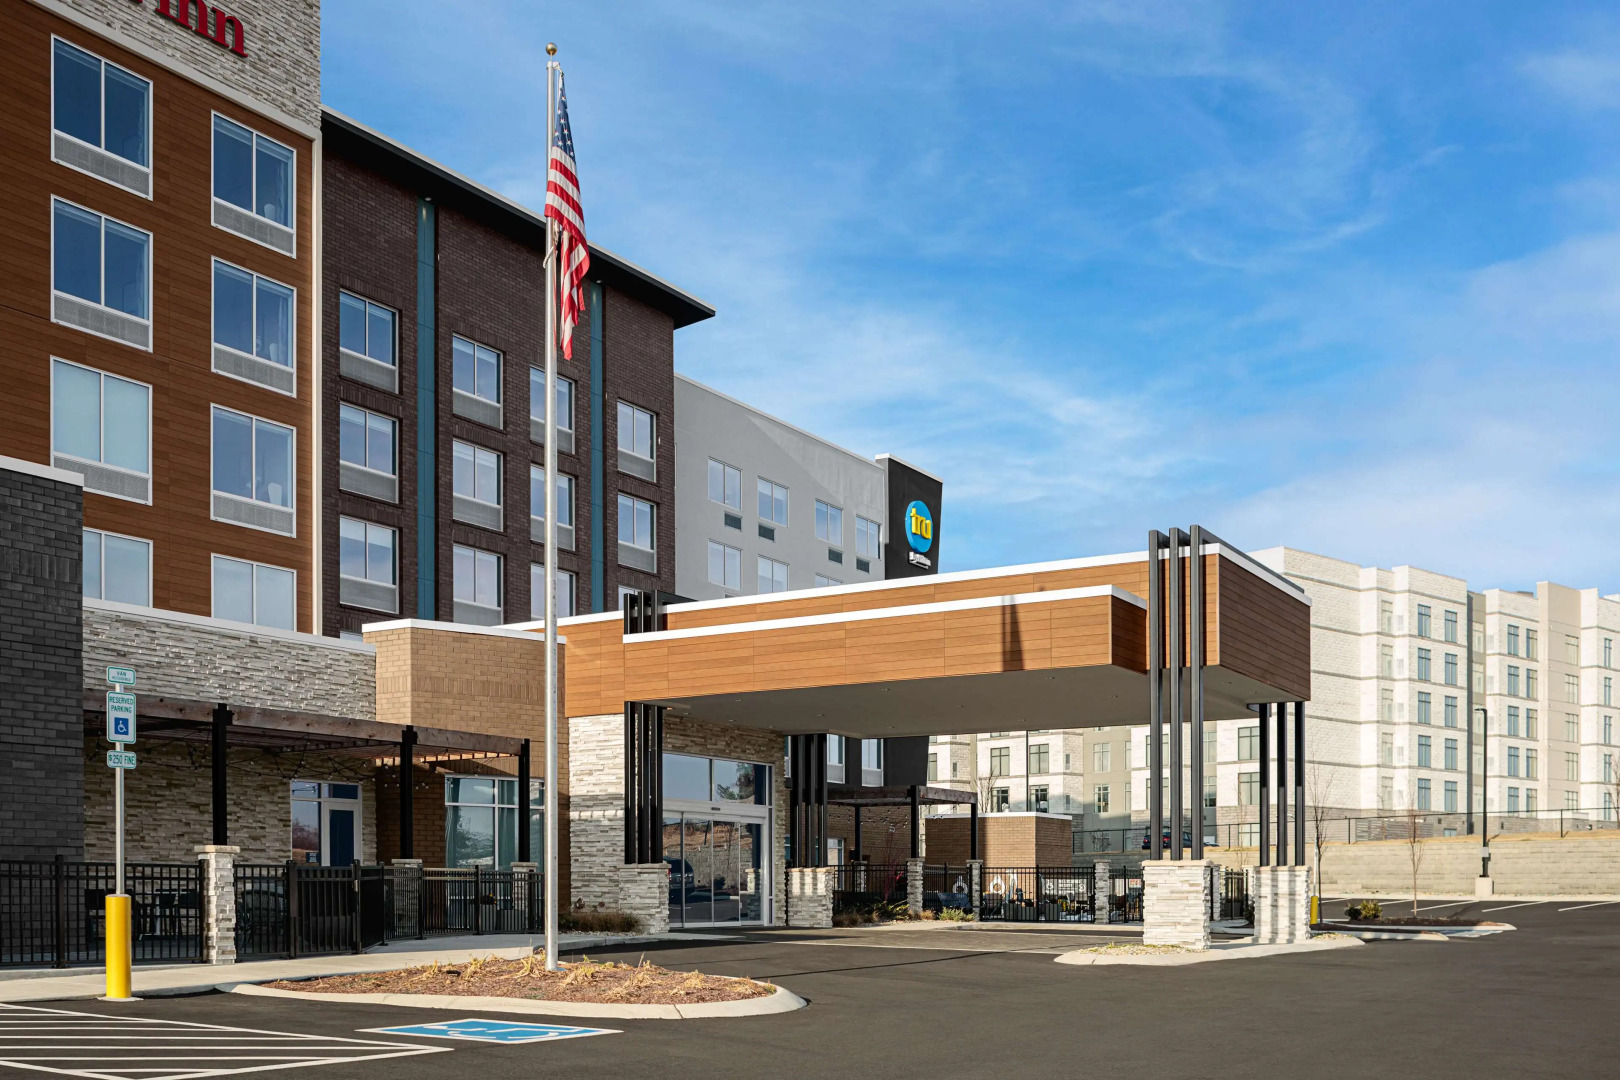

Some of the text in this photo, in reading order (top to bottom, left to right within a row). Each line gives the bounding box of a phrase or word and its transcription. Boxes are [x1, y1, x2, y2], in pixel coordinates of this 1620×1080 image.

[154, 0, 248, 57] nn
[910, 508, 931, 539] tru
[109, 696, 133, 705] RESERVED
[111, 704, 132, 713] PARKING
[124, 755, 135, 765] FINE
